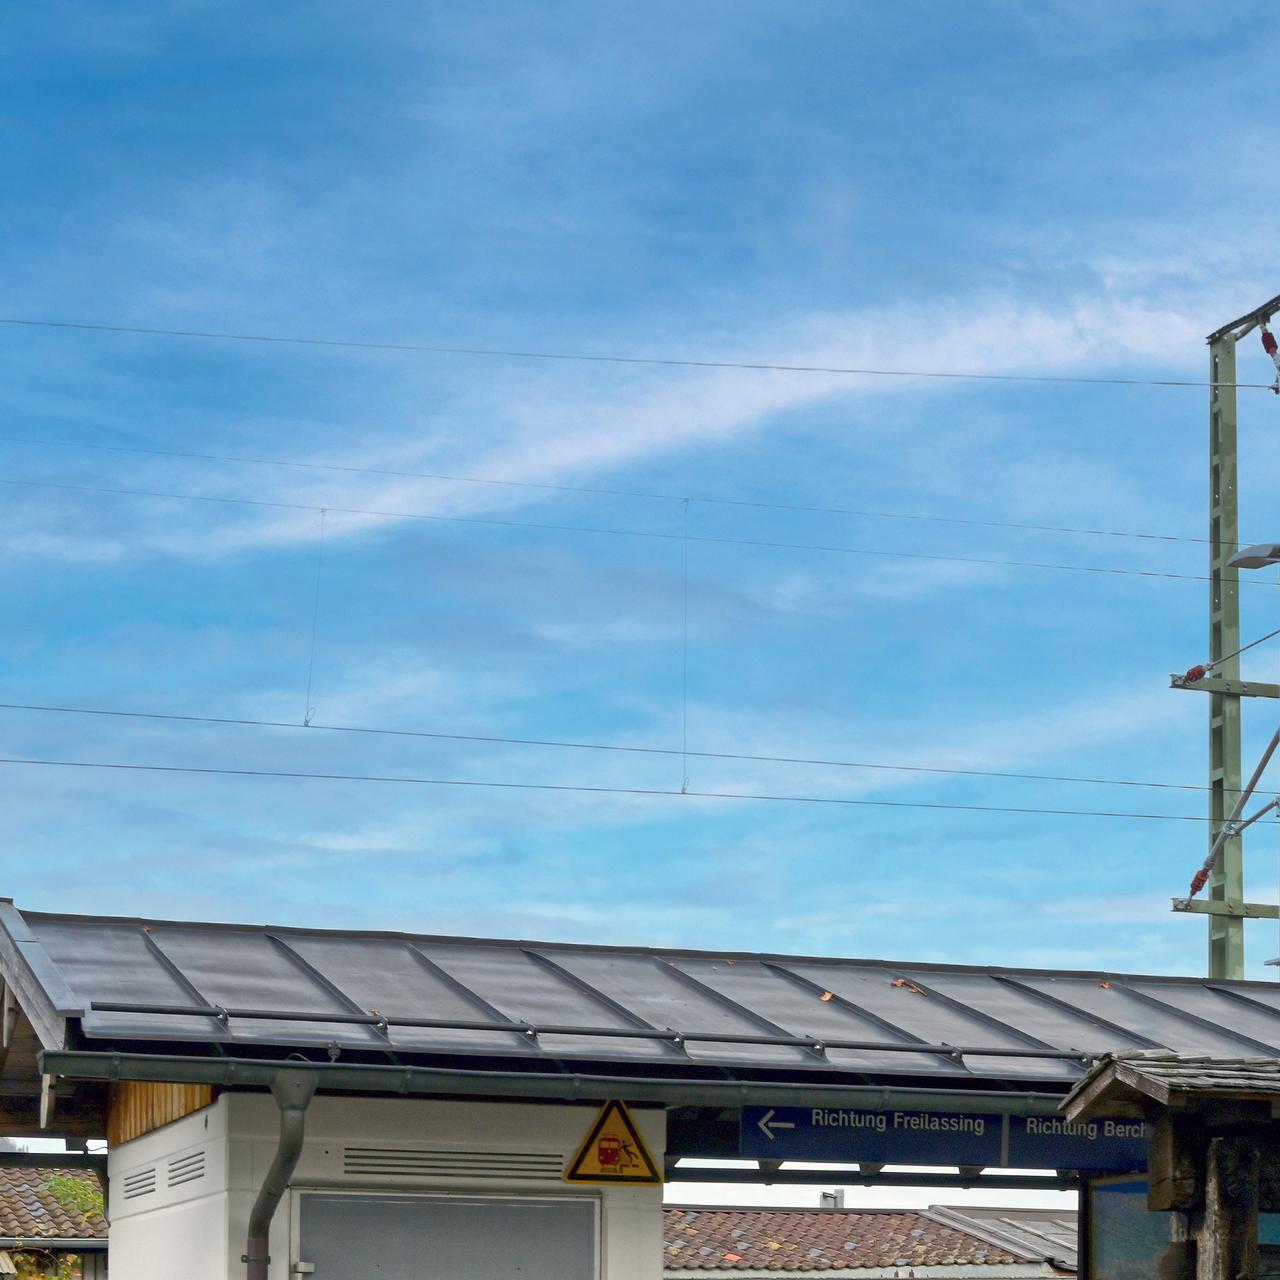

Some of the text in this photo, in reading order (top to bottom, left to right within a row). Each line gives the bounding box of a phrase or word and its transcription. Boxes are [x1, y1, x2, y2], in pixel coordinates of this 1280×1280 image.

[812, 1108, 985, 1136] Richtung Freilassing
[1026, 1117, 1098, 1140] Richtung
